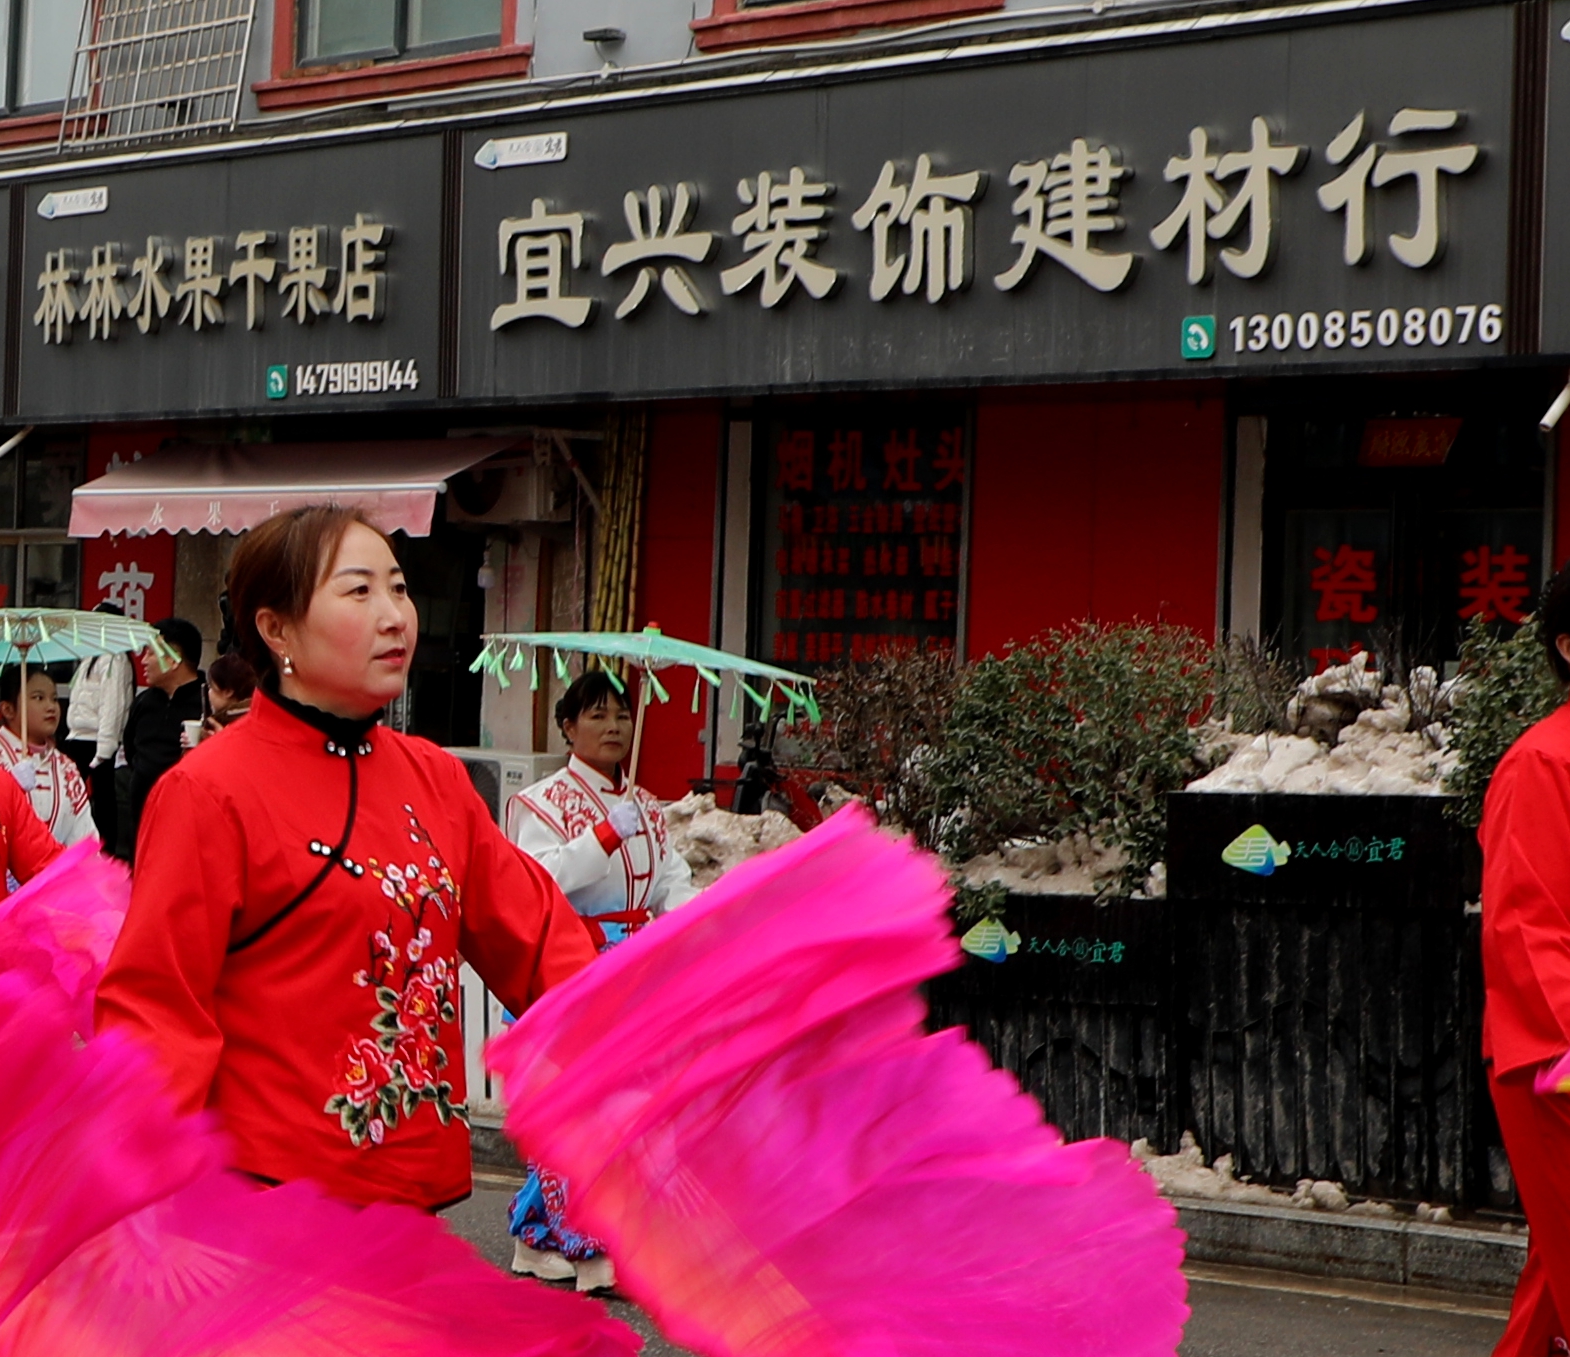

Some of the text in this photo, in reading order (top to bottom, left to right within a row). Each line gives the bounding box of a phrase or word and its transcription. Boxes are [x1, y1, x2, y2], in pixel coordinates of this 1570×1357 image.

[489, 107, 1482, 332] 宜兴装饰建材行
[33, 212, 389, 345] 林林水果干果店
[1228, 303, 1504, 353] 13008508076
[295, 359, 420, 396] 14791919144
